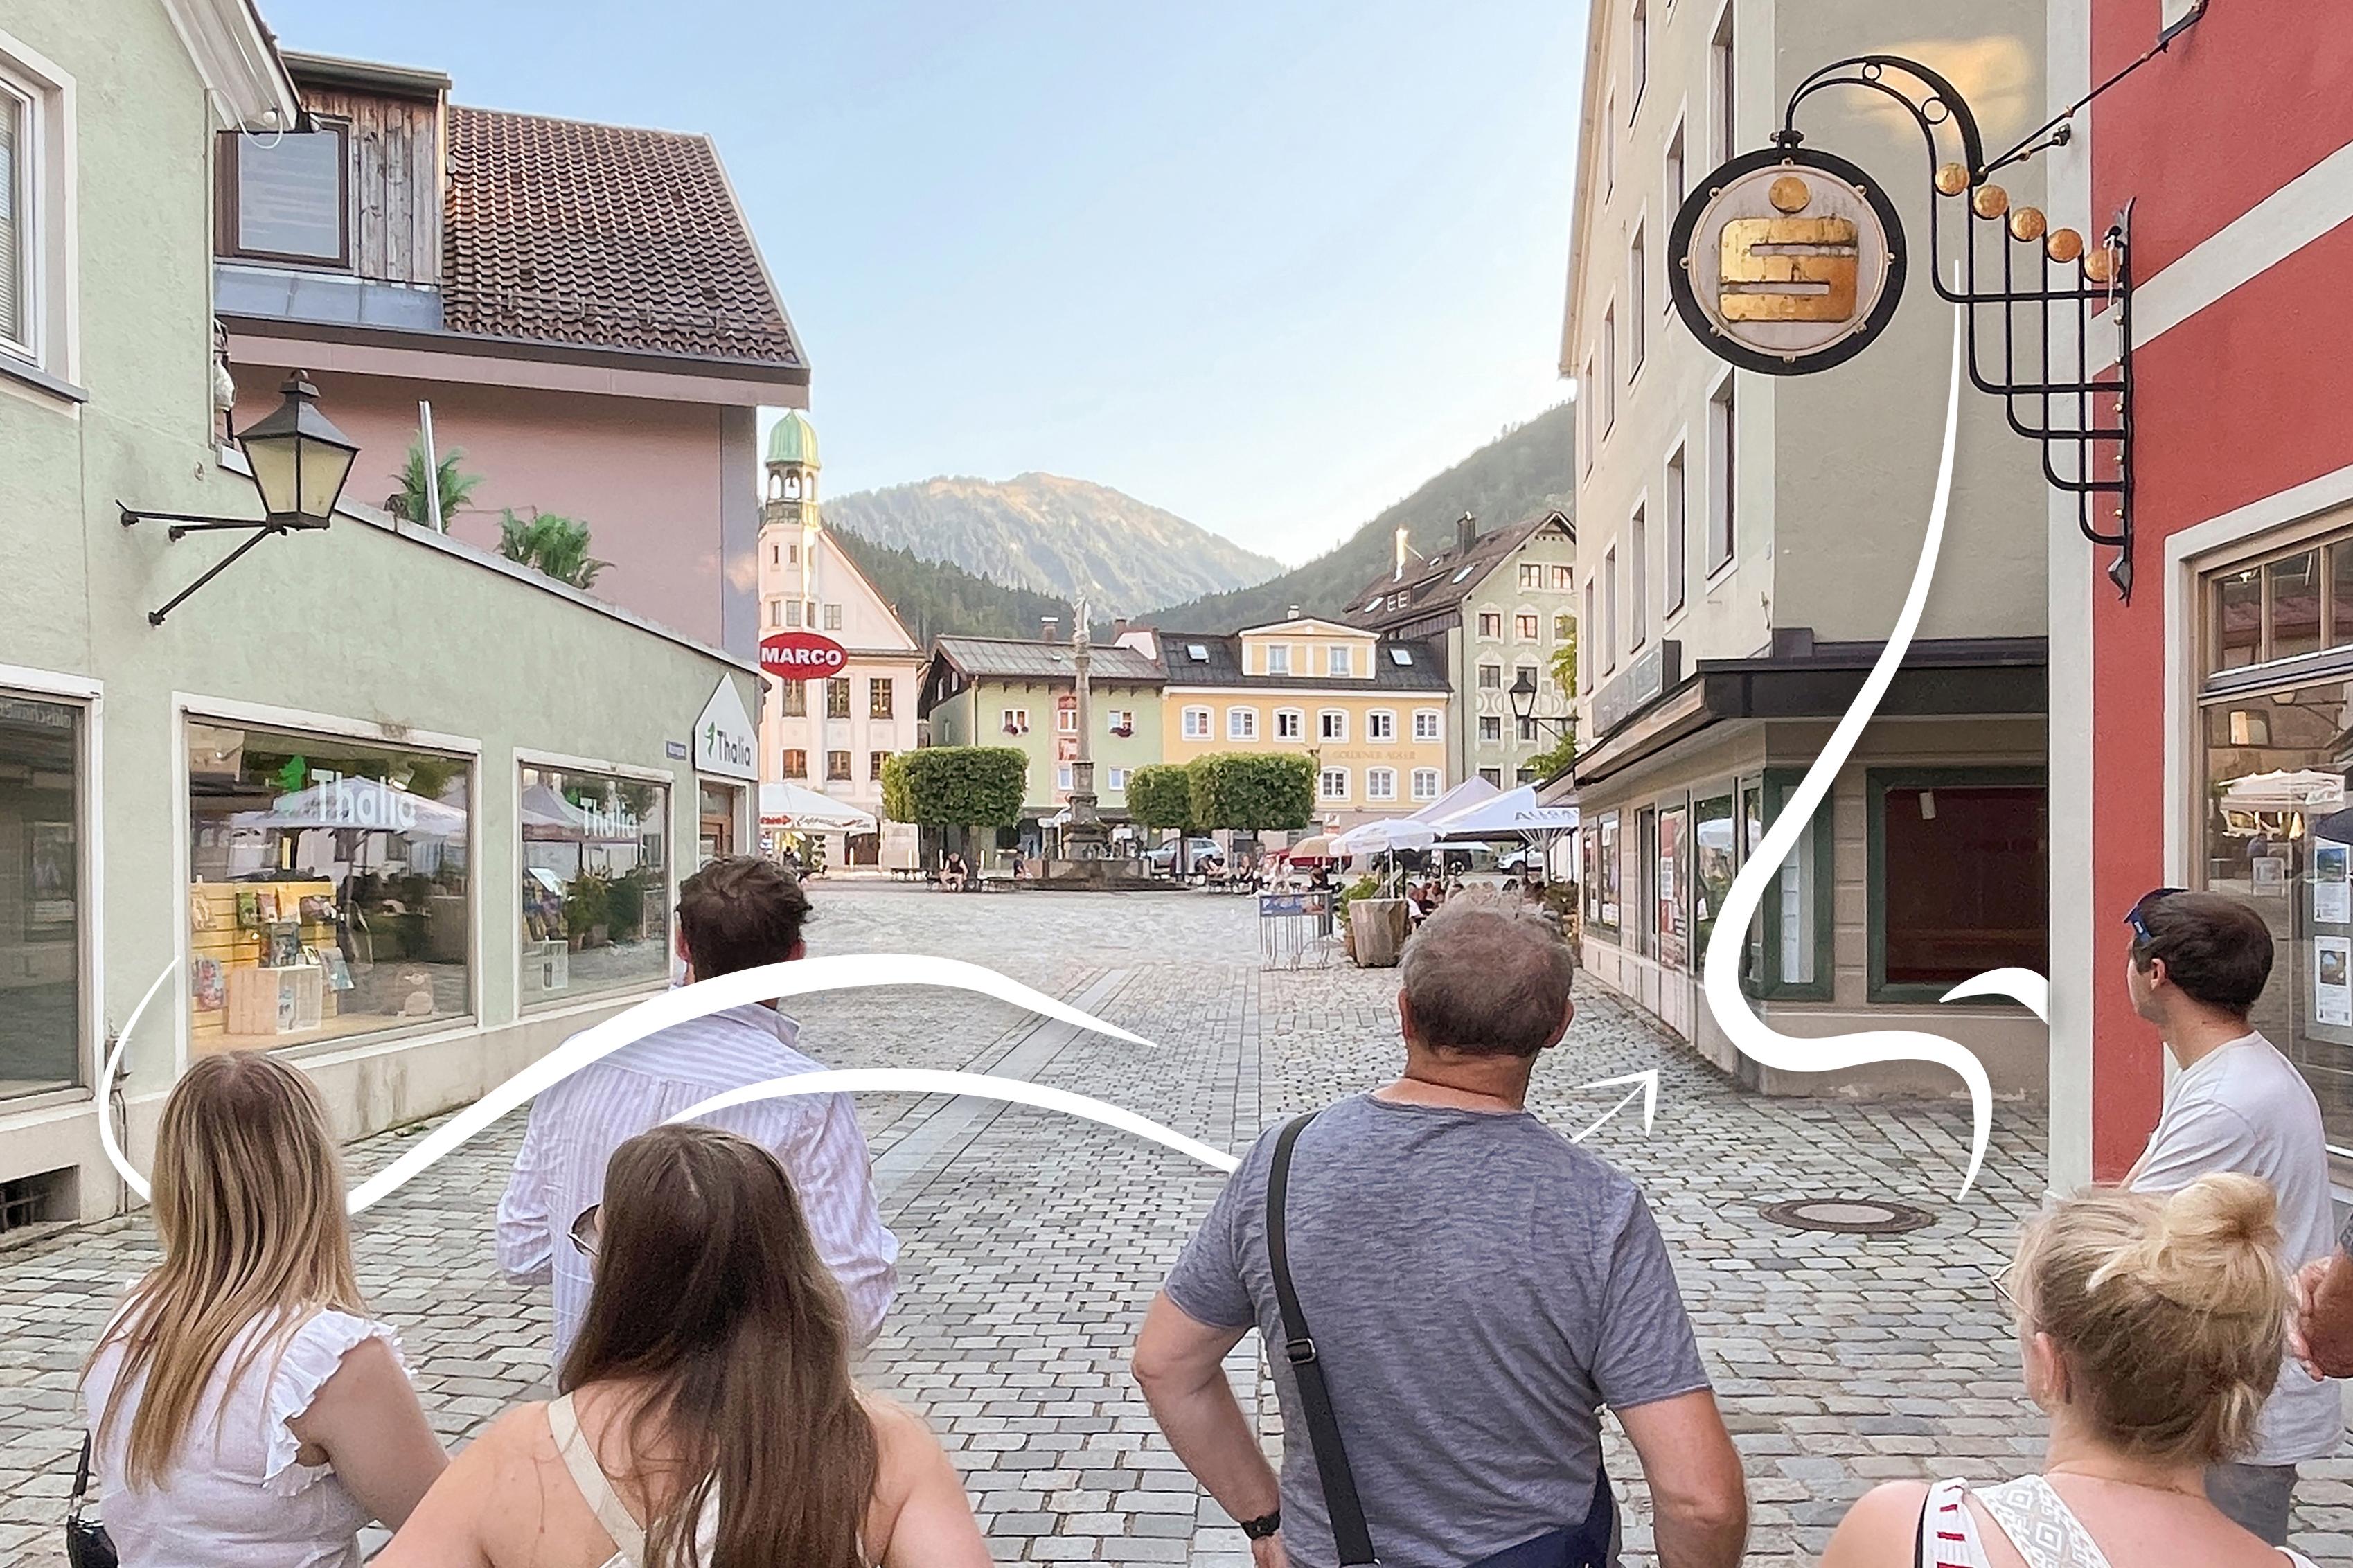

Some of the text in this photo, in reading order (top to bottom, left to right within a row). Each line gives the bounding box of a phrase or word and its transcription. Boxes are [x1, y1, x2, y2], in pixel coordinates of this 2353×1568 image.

[761, 647, 842, 666] MARCO
[717, 729, 750, 767] Thalia
[312, 769, 416, 828] Thalia
[580, 797, 638, 838] Thalia
